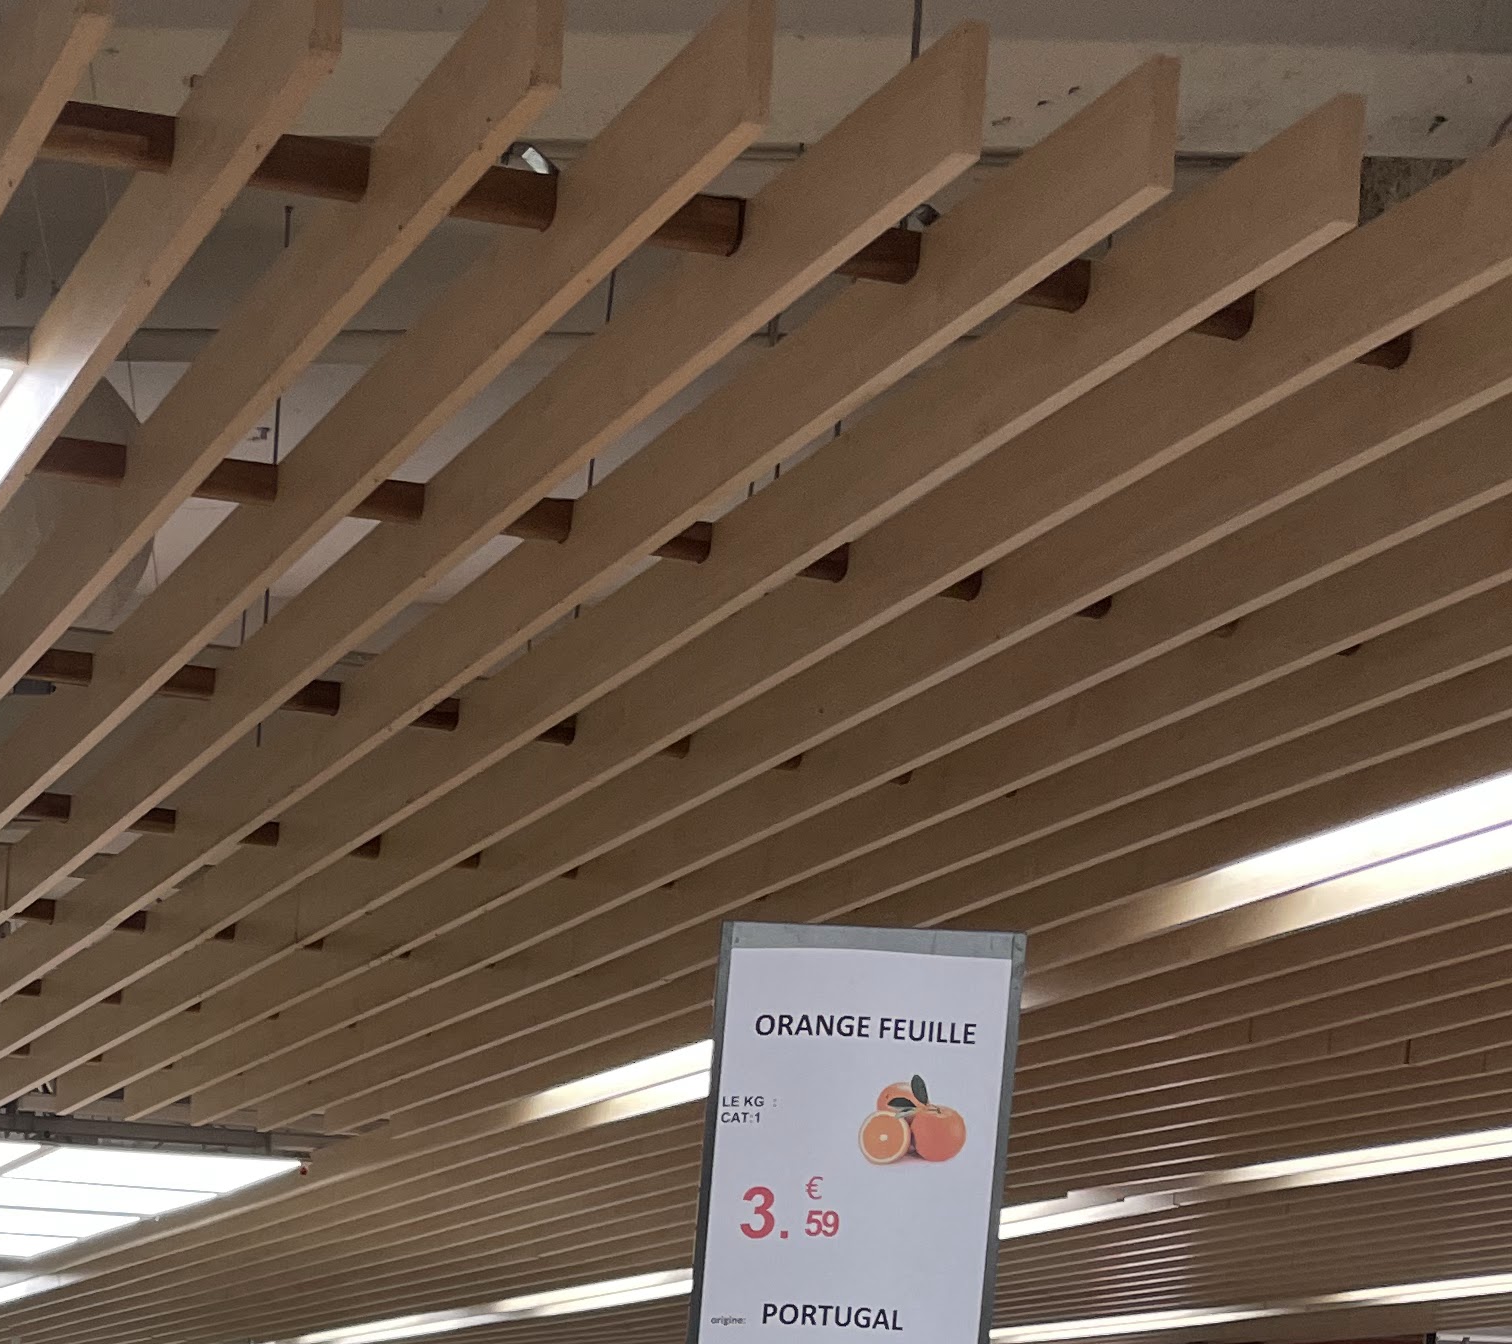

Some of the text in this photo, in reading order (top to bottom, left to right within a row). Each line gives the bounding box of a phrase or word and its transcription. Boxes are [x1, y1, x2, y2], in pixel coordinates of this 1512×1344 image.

[754, 1013, 977, 1045] ORANGE FEUILLE
[722, 1095, 765, 1107] LE KG
[761, 1302, 904, 1331] PORTUGAL
